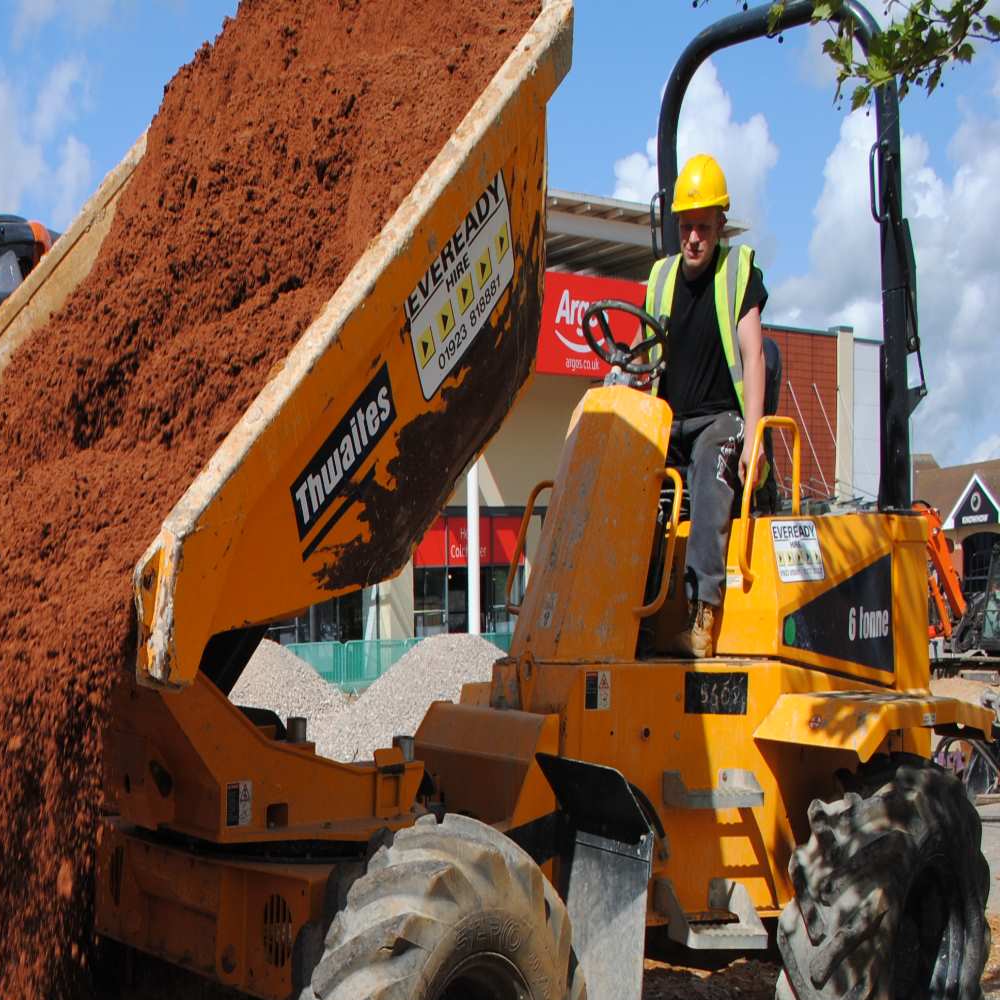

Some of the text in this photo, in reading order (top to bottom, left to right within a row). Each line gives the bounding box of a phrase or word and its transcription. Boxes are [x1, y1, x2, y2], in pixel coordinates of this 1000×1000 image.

[407, 176, 502, 315] EVEREADY
[445, 252, 471, 293] HIRE
[437, 276, 502, 371] 01923 818881
[554, 288, 609, 337] Arg
[565, 357, 600, 371] argos.co.uk
[295, 386, 391, 526] Thwaites
[772, 525, 816, 539] EVEREADY
[848, 605, 889, 641] 6 tonne
